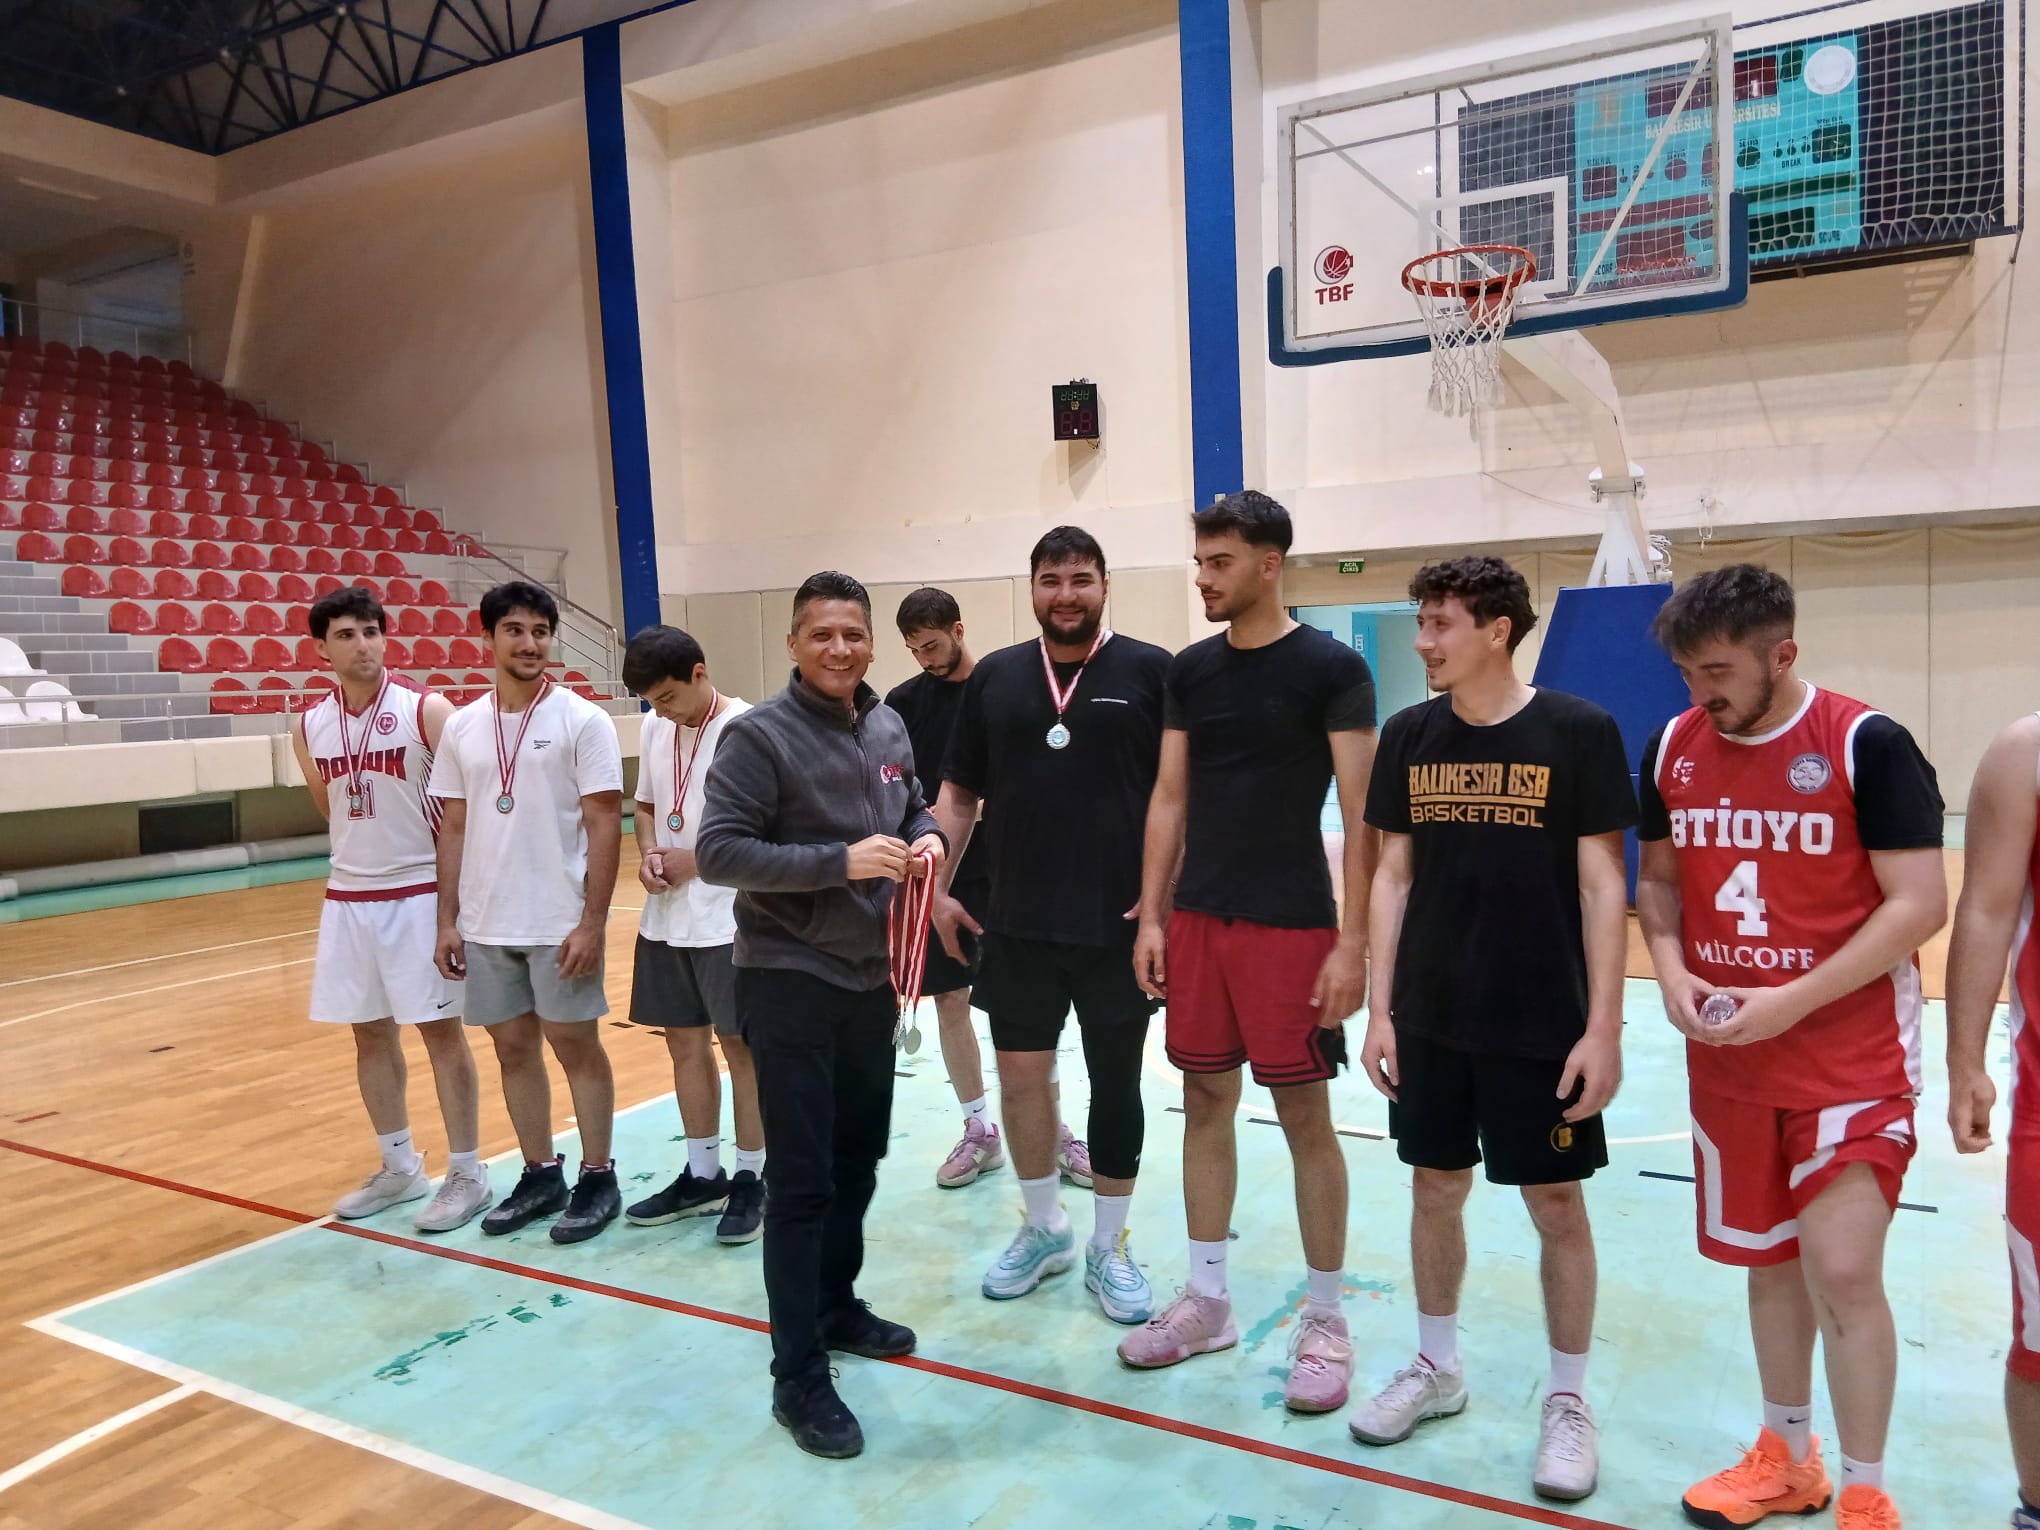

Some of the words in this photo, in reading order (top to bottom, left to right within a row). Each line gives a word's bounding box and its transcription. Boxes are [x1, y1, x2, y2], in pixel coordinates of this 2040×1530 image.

[1315, 283, 1354, 305] TBF
[345, 779, 377, 820] 21
[1410, 804, 1544, 828] BASKETBOL
[1715, 860, 1768, 937] 4
